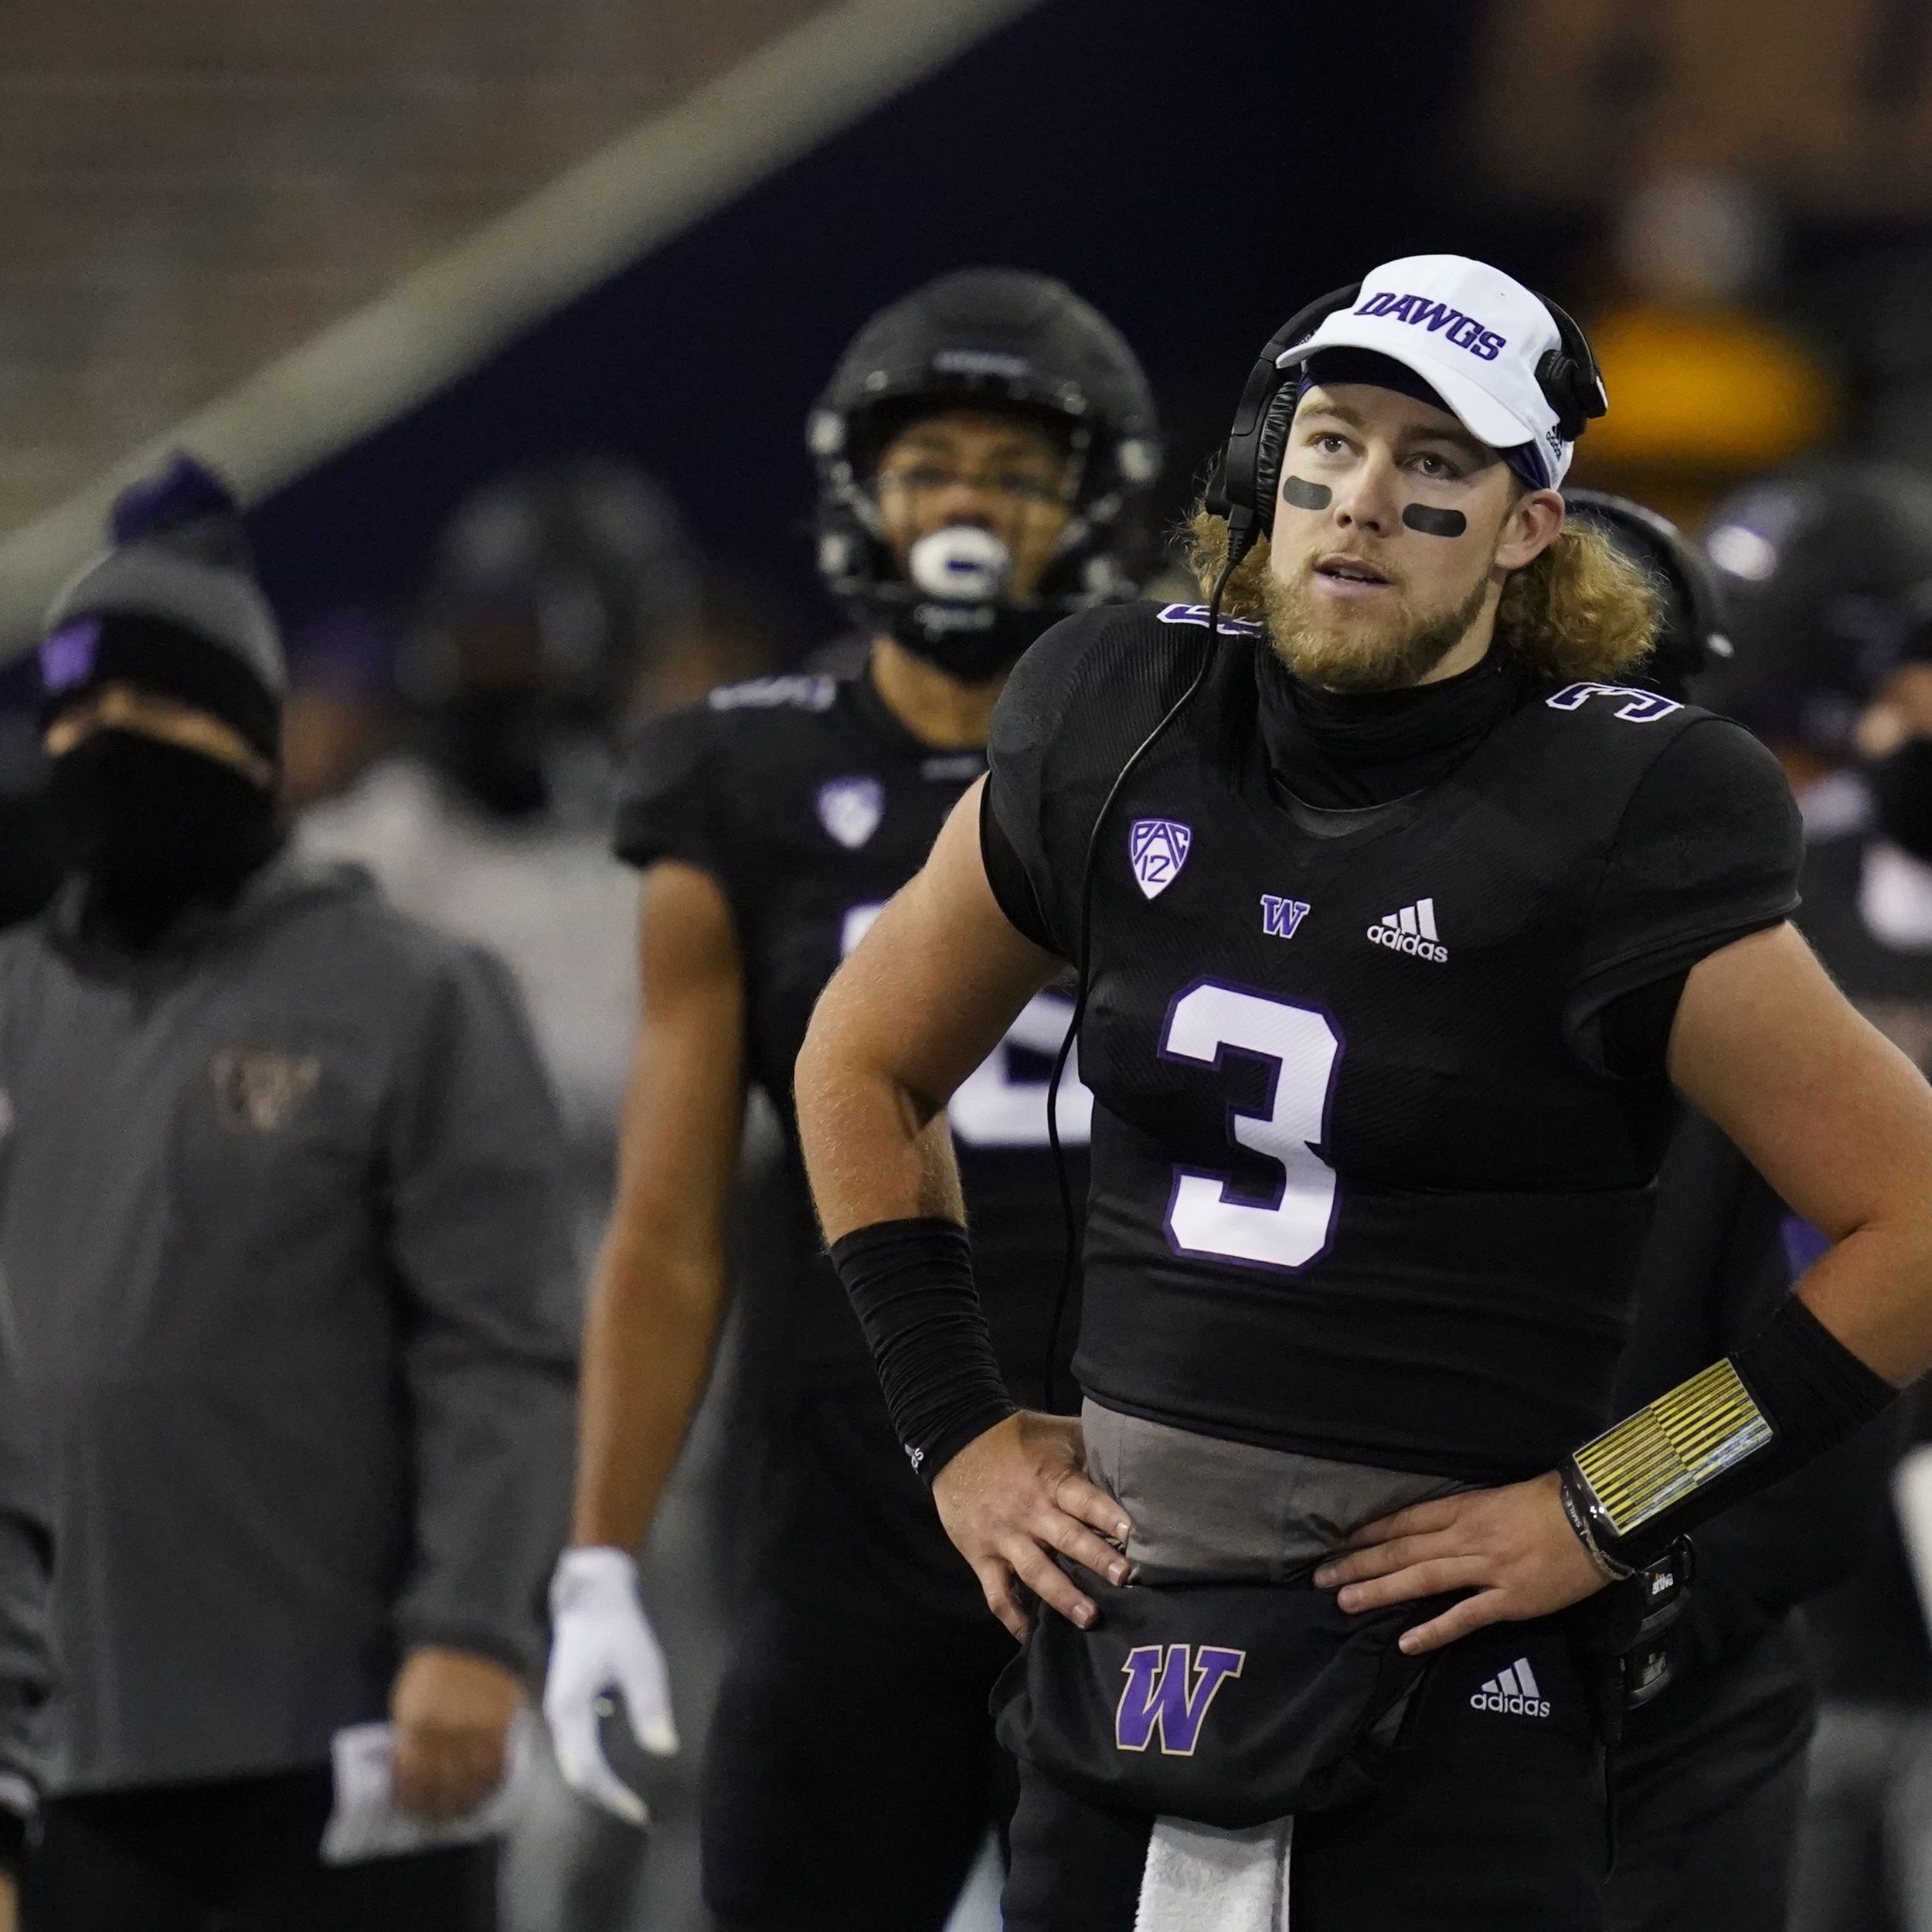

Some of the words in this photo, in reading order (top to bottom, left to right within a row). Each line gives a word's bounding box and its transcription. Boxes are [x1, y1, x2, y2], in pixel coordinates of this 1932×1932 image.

[1354, 293, 1507, 361] DAWGS
[1131, 822, 1190, 870] PAC
[1141, 854, 1171, 883] 12
[1260, 894, 1311, 939] W
[1366, 923, 1448, 964] adidas
[1158, 975, 1346, 1274] 3
[1114, 1643, 1247, 1757] W
[1470, 1692, 1551, 1718] adidas
